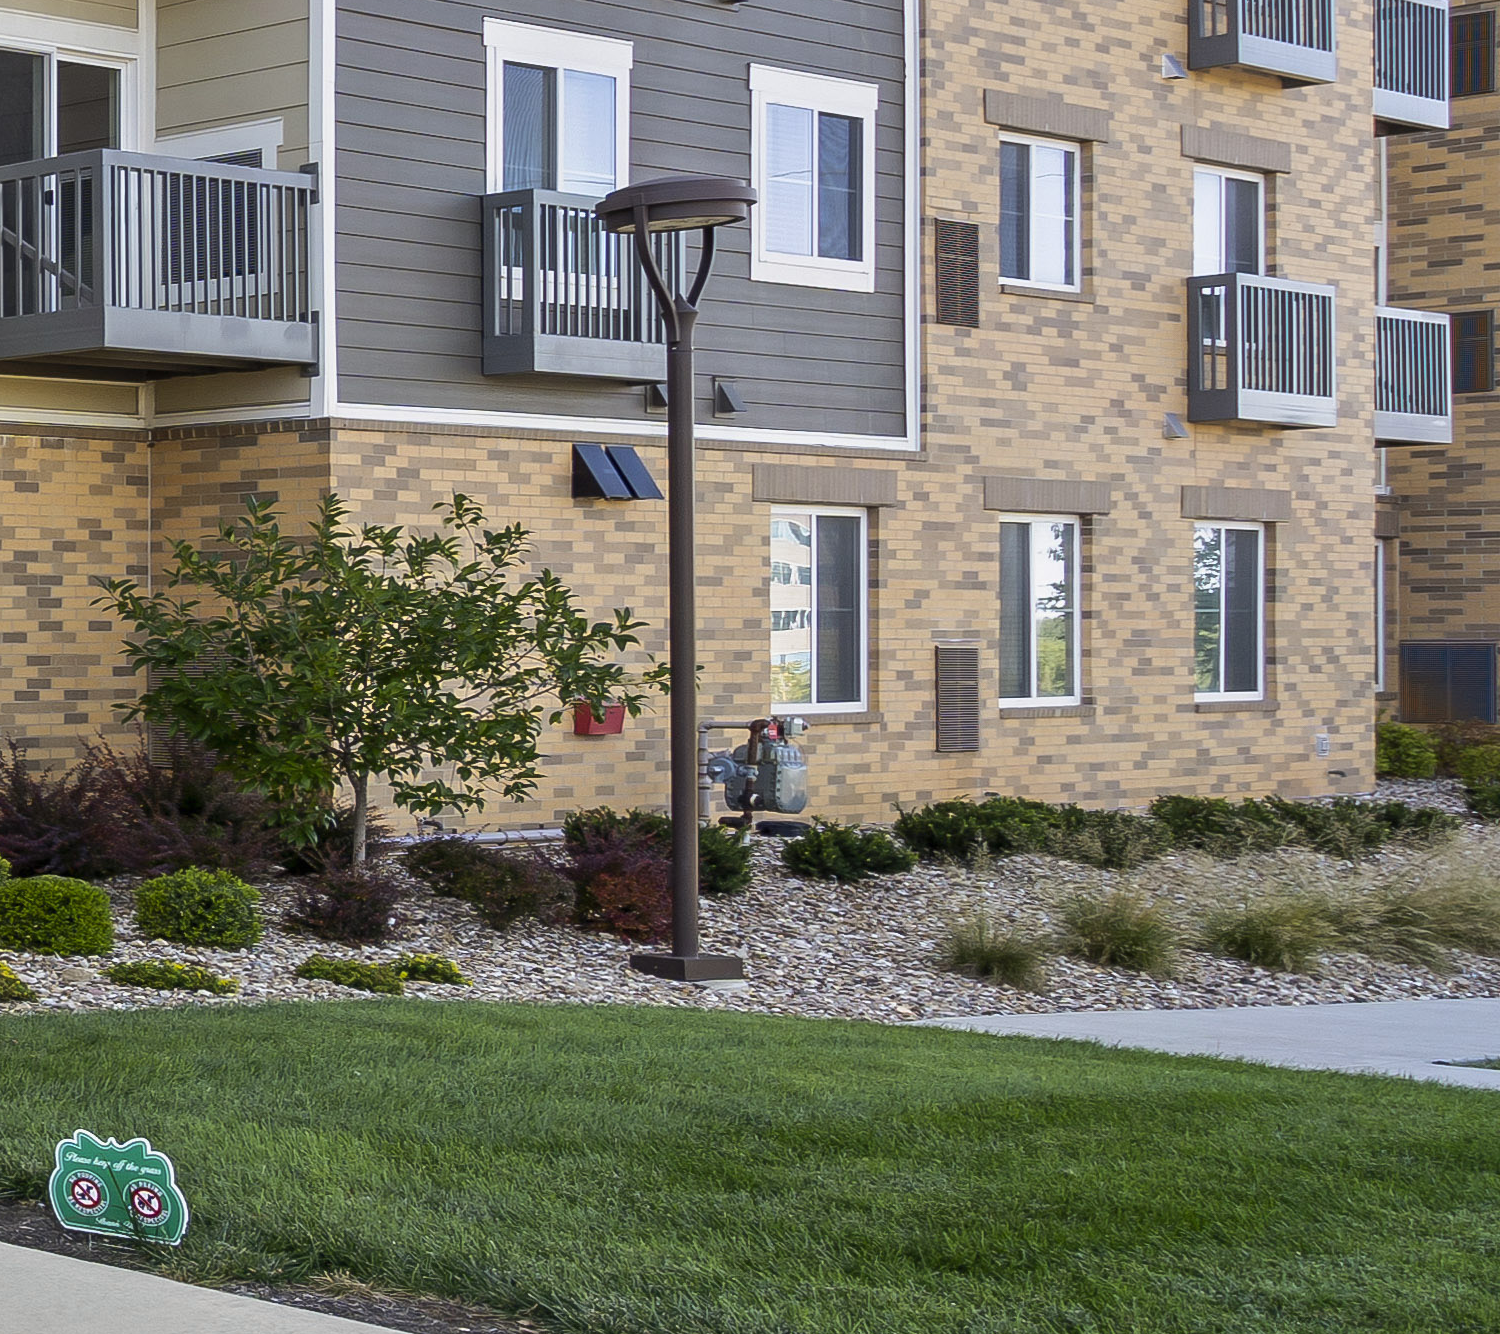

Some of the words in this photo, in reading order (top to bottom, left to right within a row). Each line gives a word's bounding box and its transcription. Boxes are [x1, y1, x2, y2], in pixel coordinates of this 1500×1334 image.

[64, 1151, 92, 1164] Please
[93, 1157, 111, 1170] keep
[112, 1159, 128, 1172] off
[125, 1162, 140, 1172] the
[138, 1166, 161, 1175] grass
